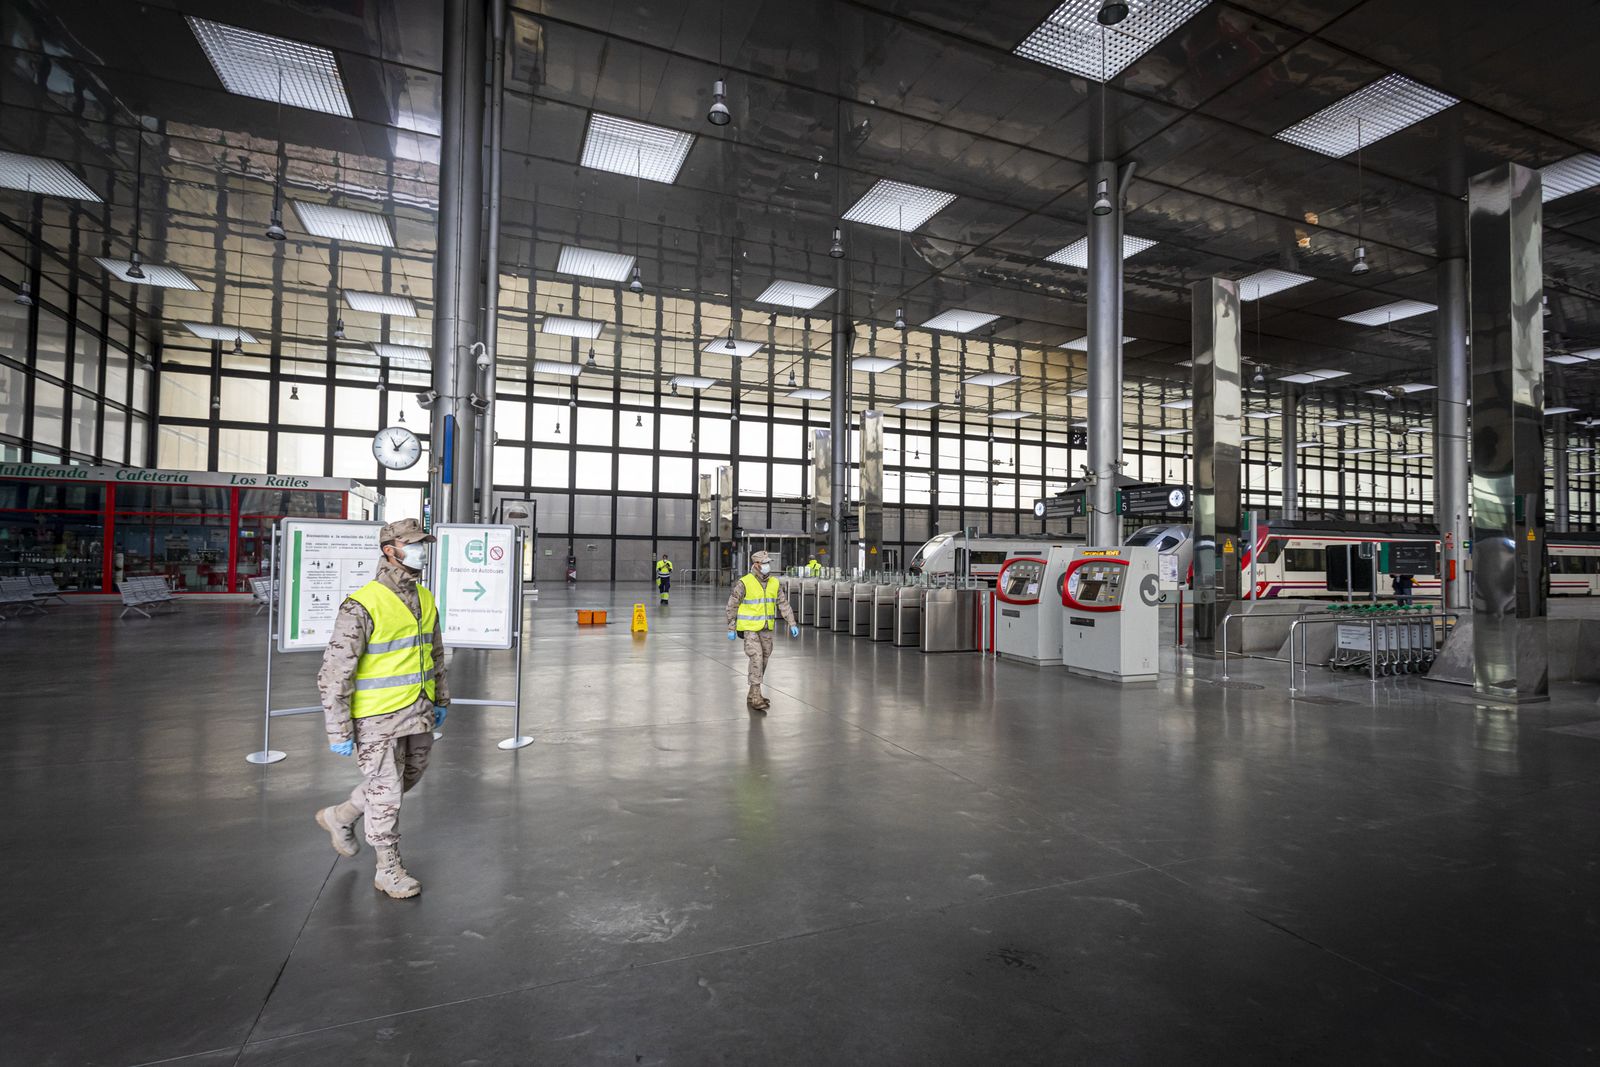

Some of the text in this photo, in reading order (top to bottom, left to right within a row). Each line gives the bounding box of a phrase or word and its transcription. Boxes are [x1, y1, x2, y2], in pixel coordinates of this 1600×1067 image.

[115, 468, 188, 483] Cafetería
[230, 474, 257, 486] Los
[265, 475, 309, 488] Railes
[1076, 505, 1081, 513] 4
[1121, 502, 1127, 511] 5
